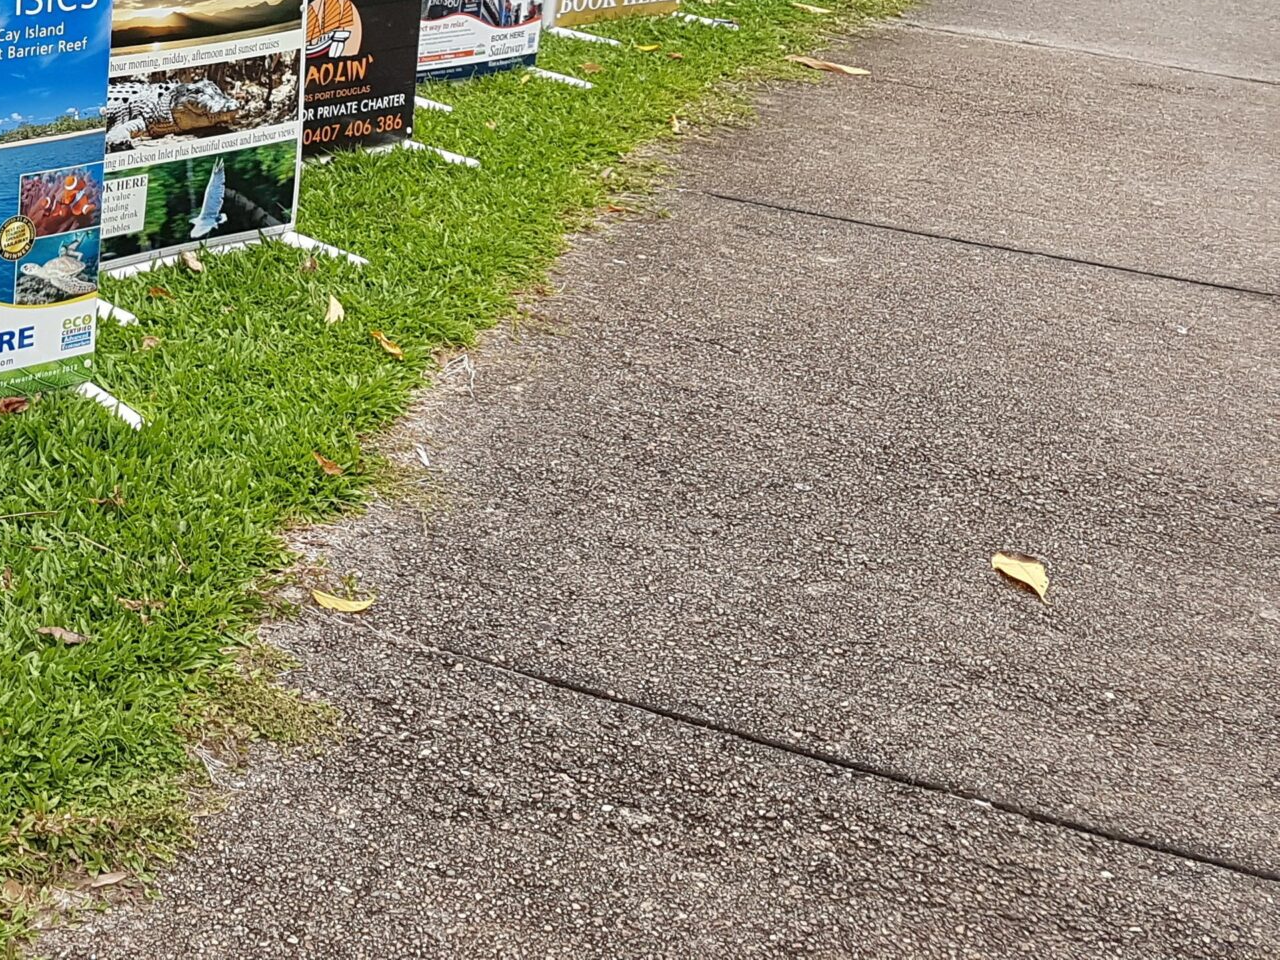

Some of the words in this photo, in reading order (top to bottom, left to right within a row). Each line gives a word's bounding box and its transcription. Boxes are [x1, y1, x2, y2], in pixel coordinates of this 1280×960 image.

[26, 22, 64, 39] Island
[491, 32, 508, 42] BOOK
[8, 42, 54, 60] Barrier
[58, 36, 88, 52] Reef
[489, 44, 525, 58] Sailaway
[314, 92, 334, 101] PORT
[336, 85, 371, 97] DOUGLAS
[318, 101, 358, 119] PRIVATE
[361, 94, 405, 112] CHARTER
[304, 124, 340, 145] 0407
[345, 119, 372, 138] 406
[376, 113, 402, 132] 386
